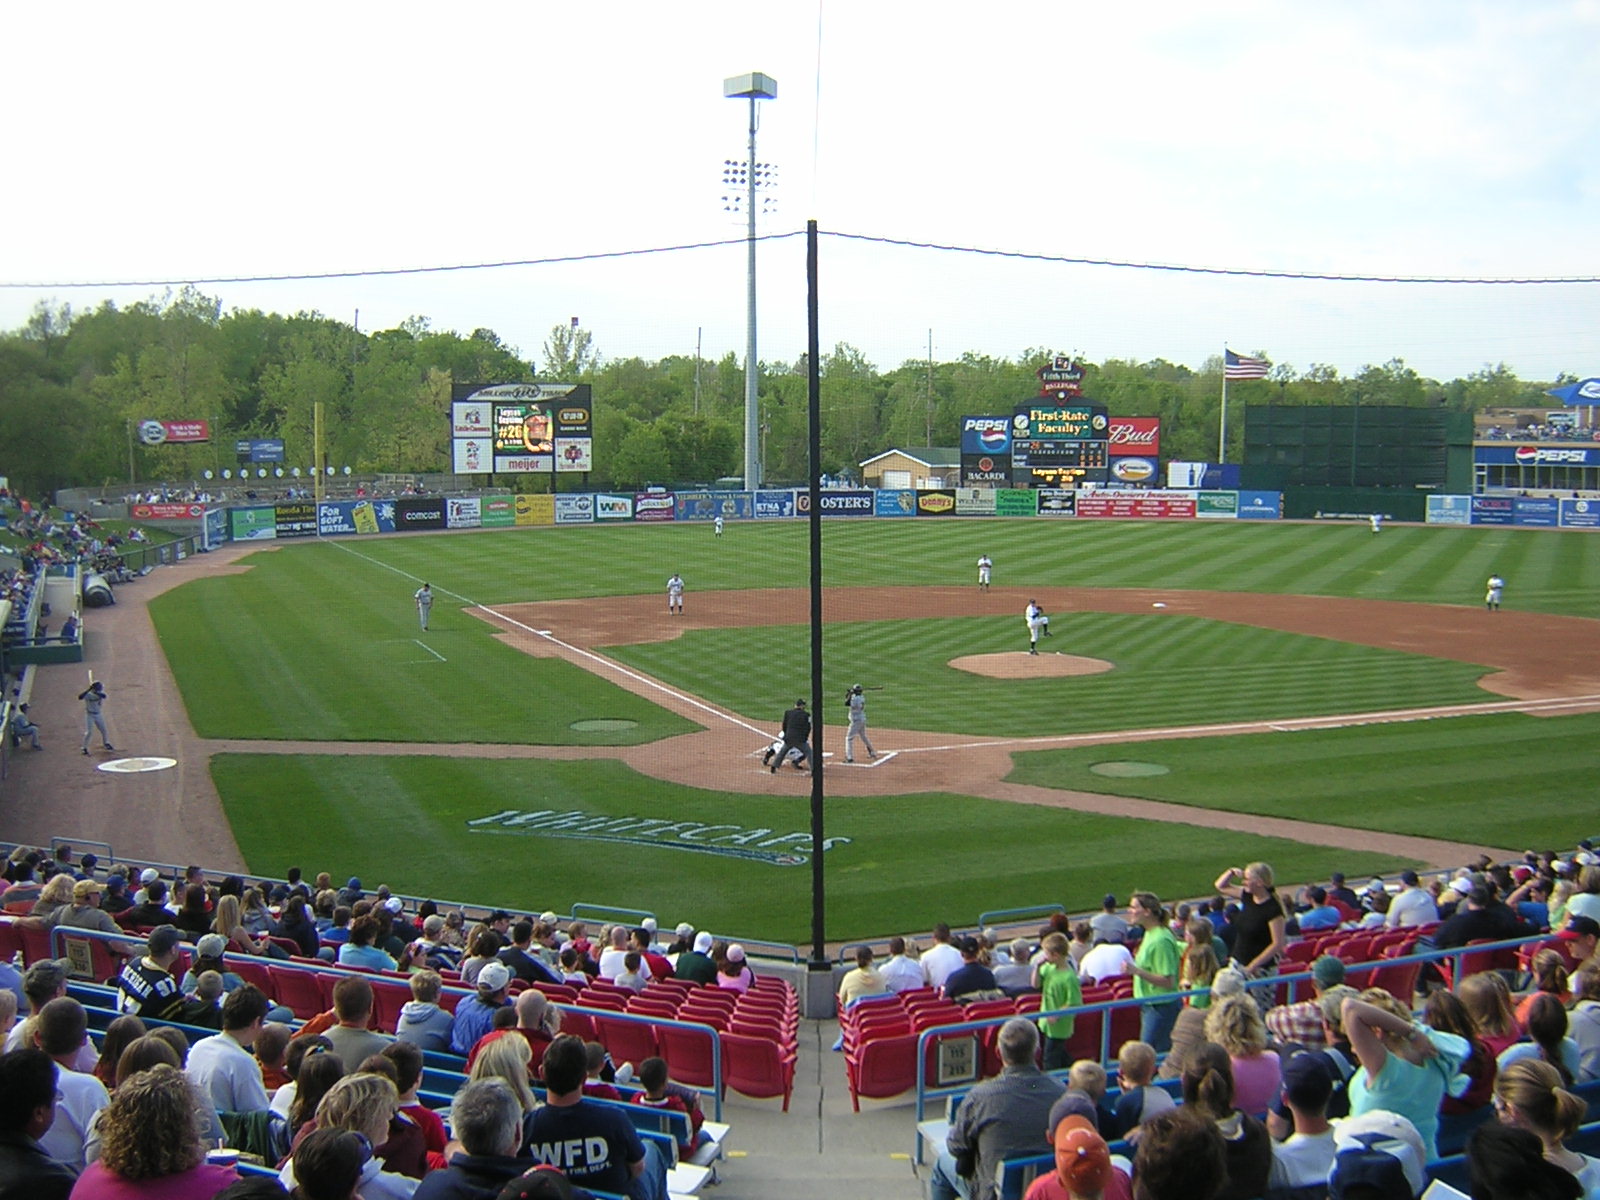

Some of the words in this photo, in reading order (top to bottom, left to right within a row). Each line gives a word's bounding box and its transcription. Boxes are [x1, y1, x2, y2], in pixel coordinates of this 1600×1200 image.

[1030, 409, 1089, 421] First-Rate
[965, 419, 1008, 431] PEPSI
[1038, 423, 1081, 435] Faculty
[499, 425, 523, 438] #26
[1108, 424, 1158, 444] Bud
[1537, 451, 1587, 462] PEPSI
[508, 458, 539, 470] meijer
[968, 472, 1005, 480] BACARDI
[820, 497, 871, 508] OSTER'S
[921, 497, 951, 507] Denny's
[320, 506, 340, 516] FOR
[320, 516, 343, 524] SOFT
[467, 809, 851, 852] WHITECAPS
[530, 1136, 609, 1167] WFD
[569, 1166, 587, 1175] FIRE
